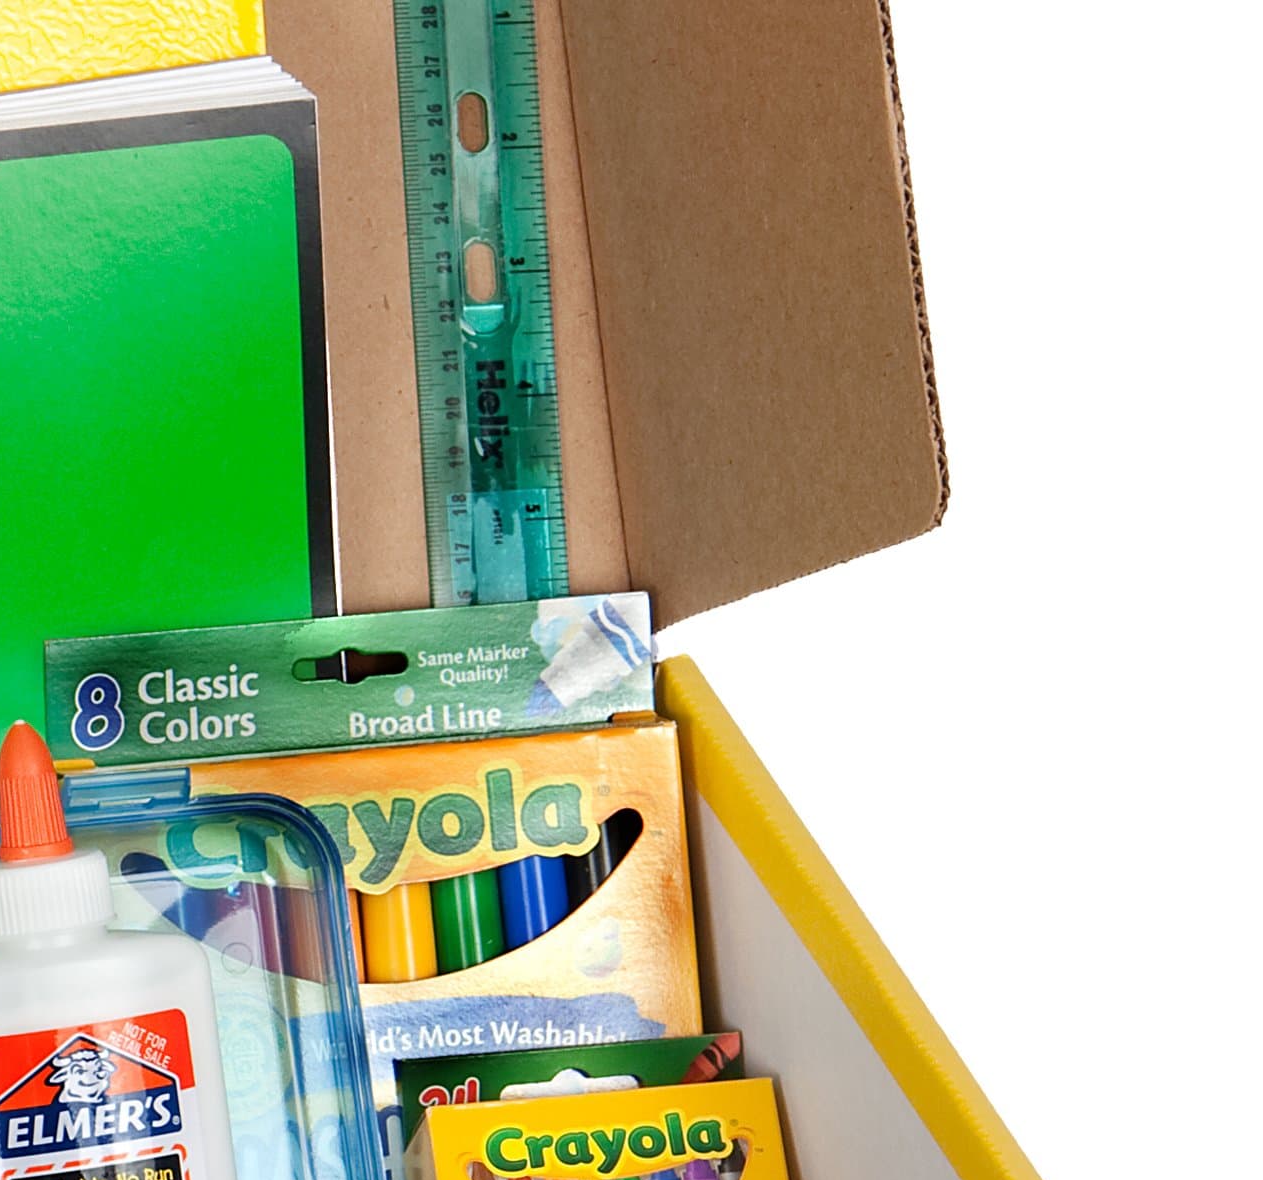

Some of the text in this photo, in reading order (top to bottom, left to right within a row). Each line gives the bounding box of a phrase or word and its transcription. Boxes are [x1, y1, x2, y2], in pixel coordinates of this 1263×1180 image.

[475, 359, 510, 469] Helix
[418, 643, 530, 668] Same Marker
[138, 664, 260, 706] Classic
[440, 664, 510, 688] Quality!
[72, 675, 124, 750] 8
[139, 706, 257, 745] Colors
[349, 704, 502, 739] Broad Line
[123, 1021, 168, 1051] NOT FOR
[419, 1024, 485, 1050] Most
[142, 1047, 171, 1069] SALE
[6, 1092, 172, 1150] ELMER'S
[487, 1113, 727, 1174] Crayola
